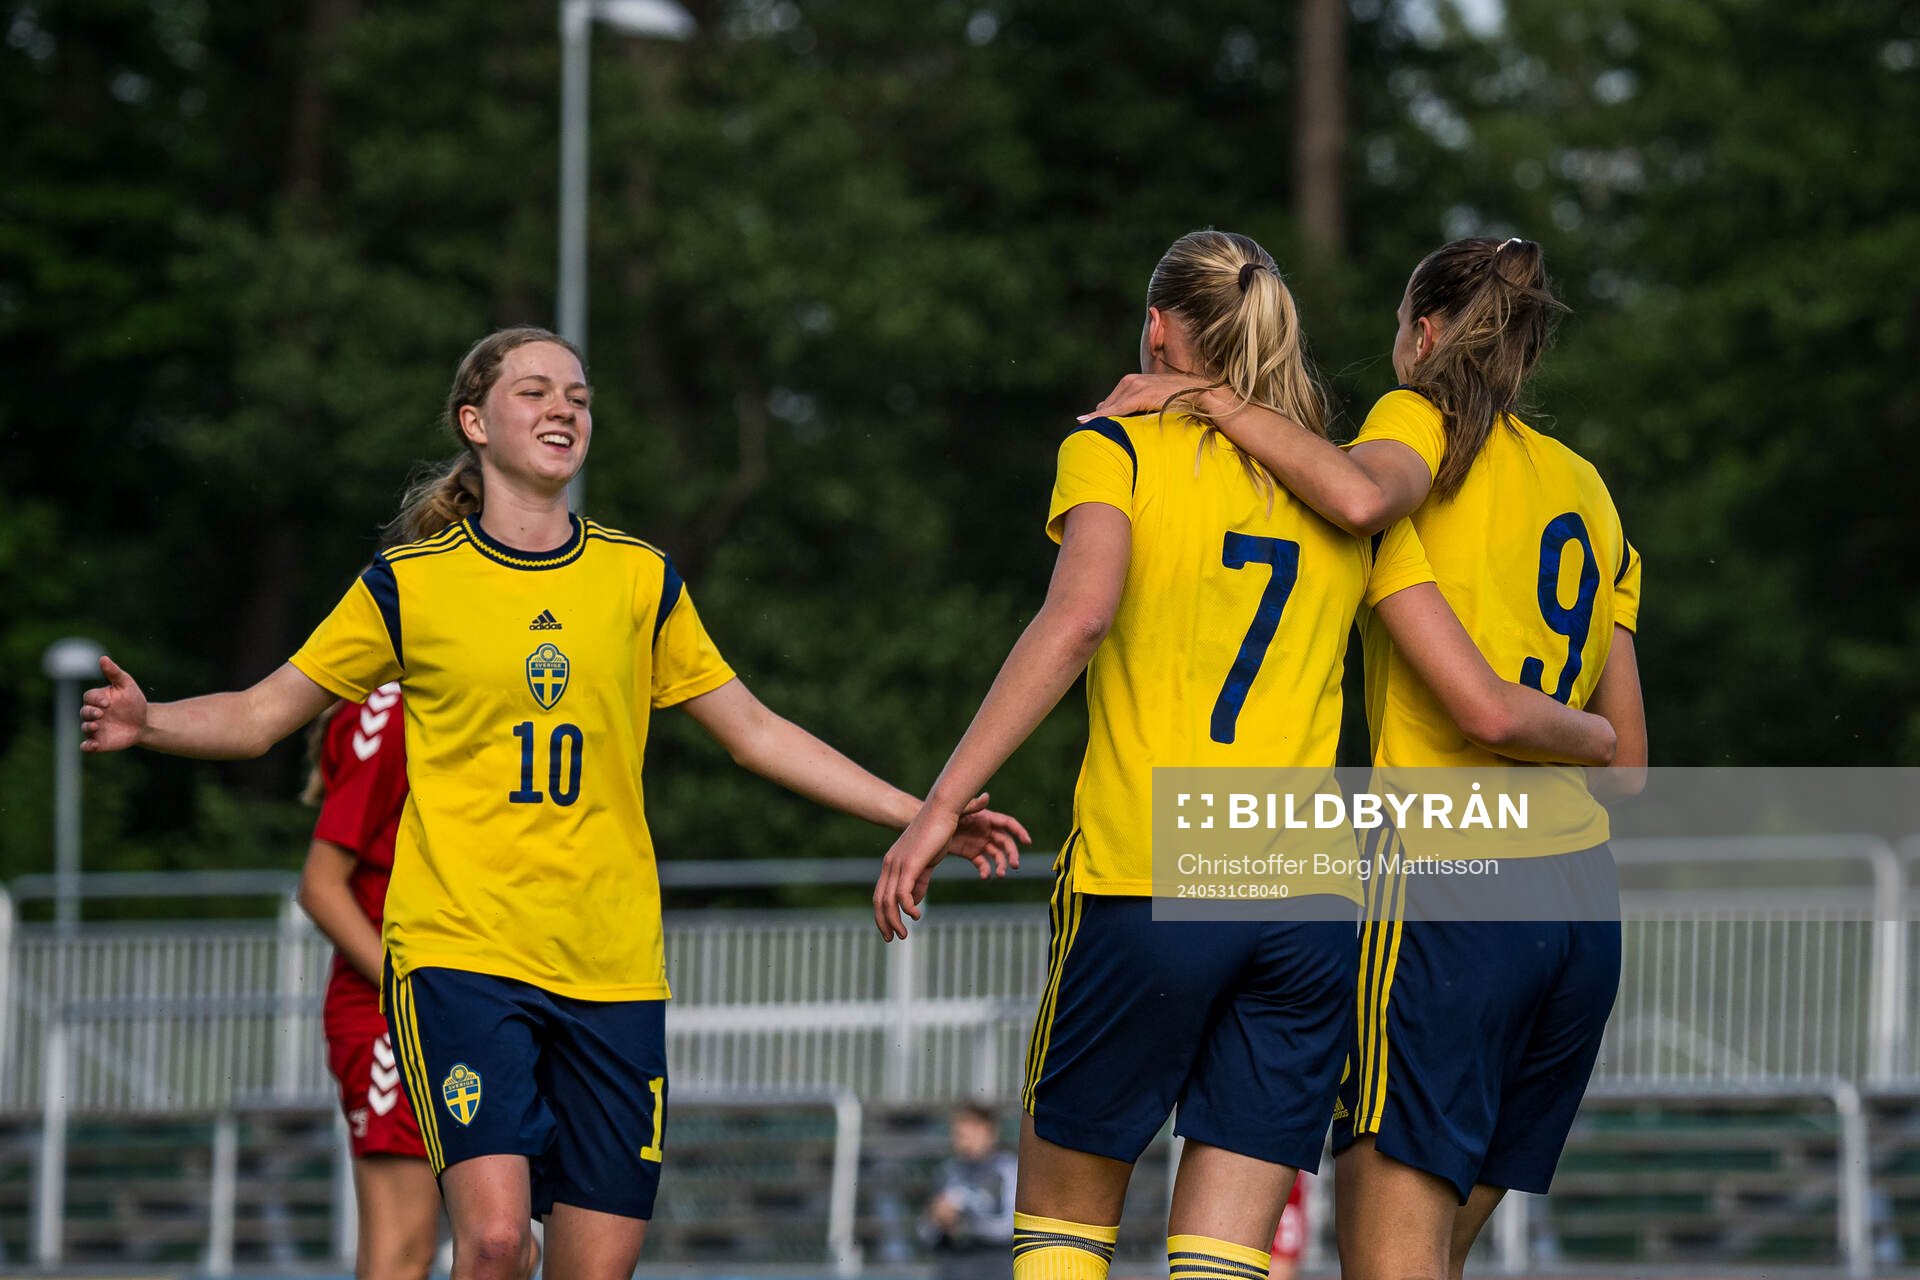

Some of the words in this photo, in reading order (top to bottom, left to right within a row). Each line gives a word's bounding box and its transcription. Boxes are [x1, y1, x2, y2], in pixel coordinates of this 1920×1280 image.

[529, 622, 563, 631] adidas
[1210, 530, 1300, 745] 7
[1519, 511, 1600, 705] 9
[508, 721, 584, 807] 10
